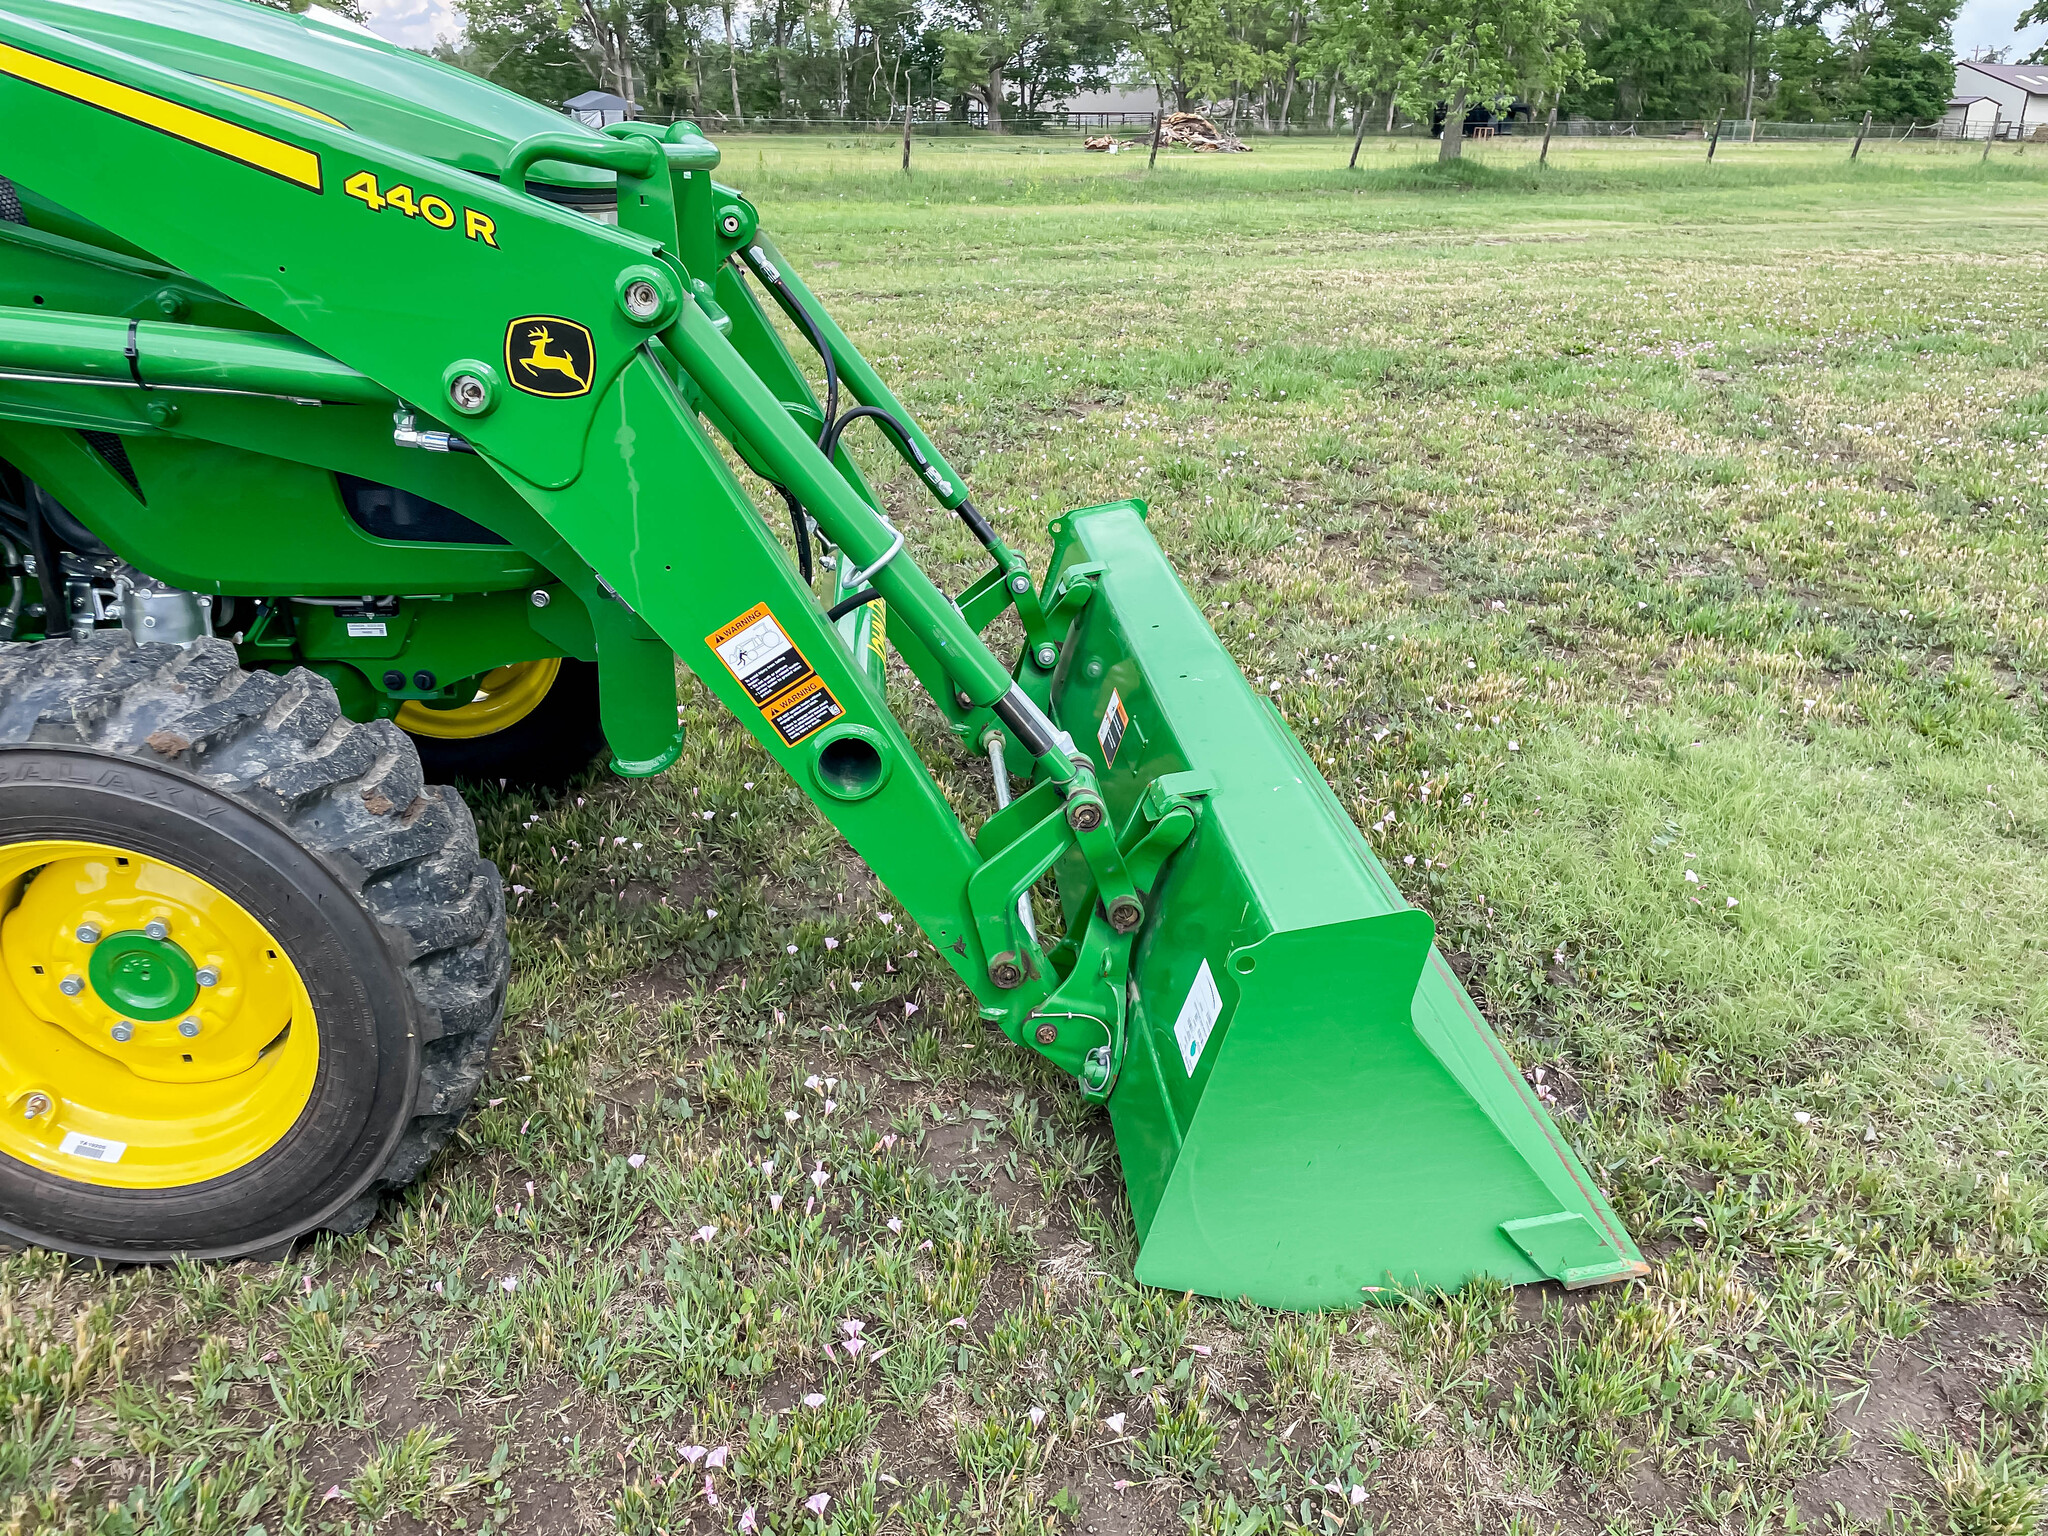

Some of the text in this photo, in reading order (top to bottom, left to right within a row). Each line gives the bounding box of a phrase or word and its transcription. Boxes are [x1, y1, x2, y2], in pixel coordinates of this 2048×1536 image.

[343, 169, 502, 251] 440 R
[722, 610, 762, 637] WARNING
[779, 682, 818, 709] WARNING
